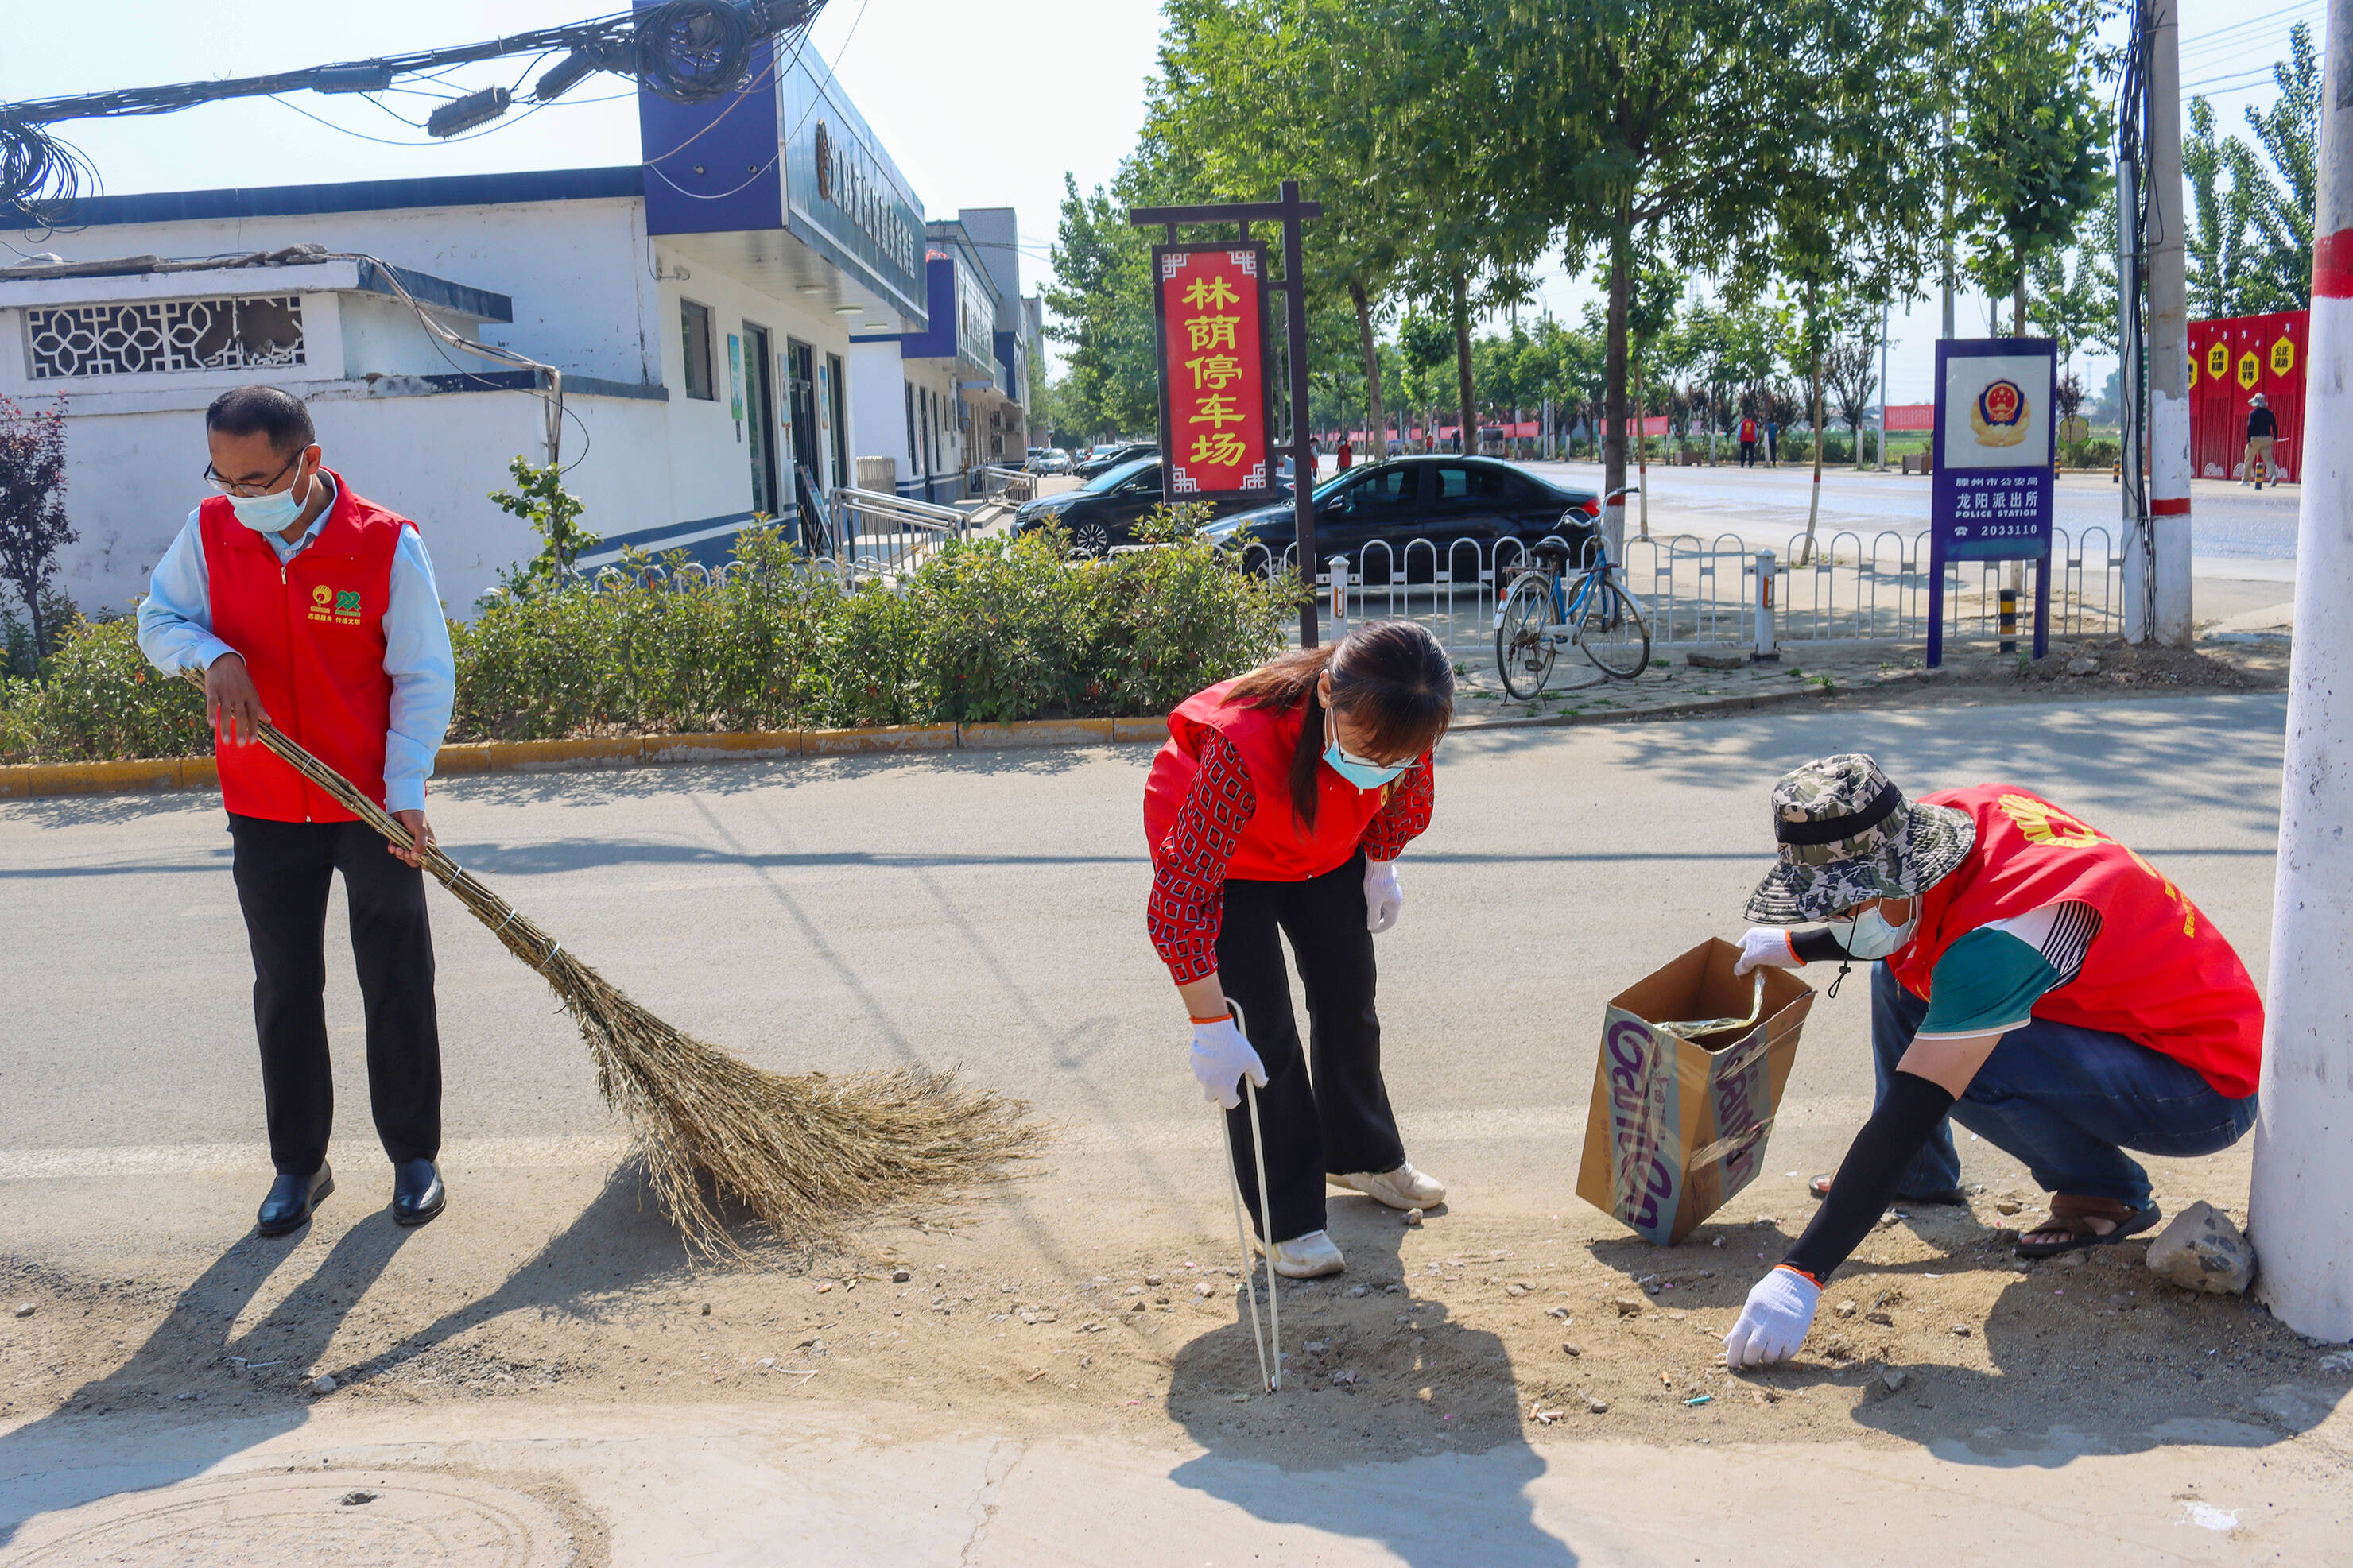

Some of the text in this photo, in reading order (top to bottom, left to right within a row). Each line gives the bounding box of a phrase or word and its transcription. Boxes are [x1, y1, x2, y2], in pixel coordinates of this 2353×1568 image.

[2275, 346, 2289, 357] 公正
[1181, 275, 1246, 467] 林荫停车场
[1956, 477, 2038, 487] 滕州市公安局
[1956, 491, 2038, 509] 龙阳派出所
[1997, 509, 2037, 517] STATION
[1980, 524, 2037, 536] 2033110
